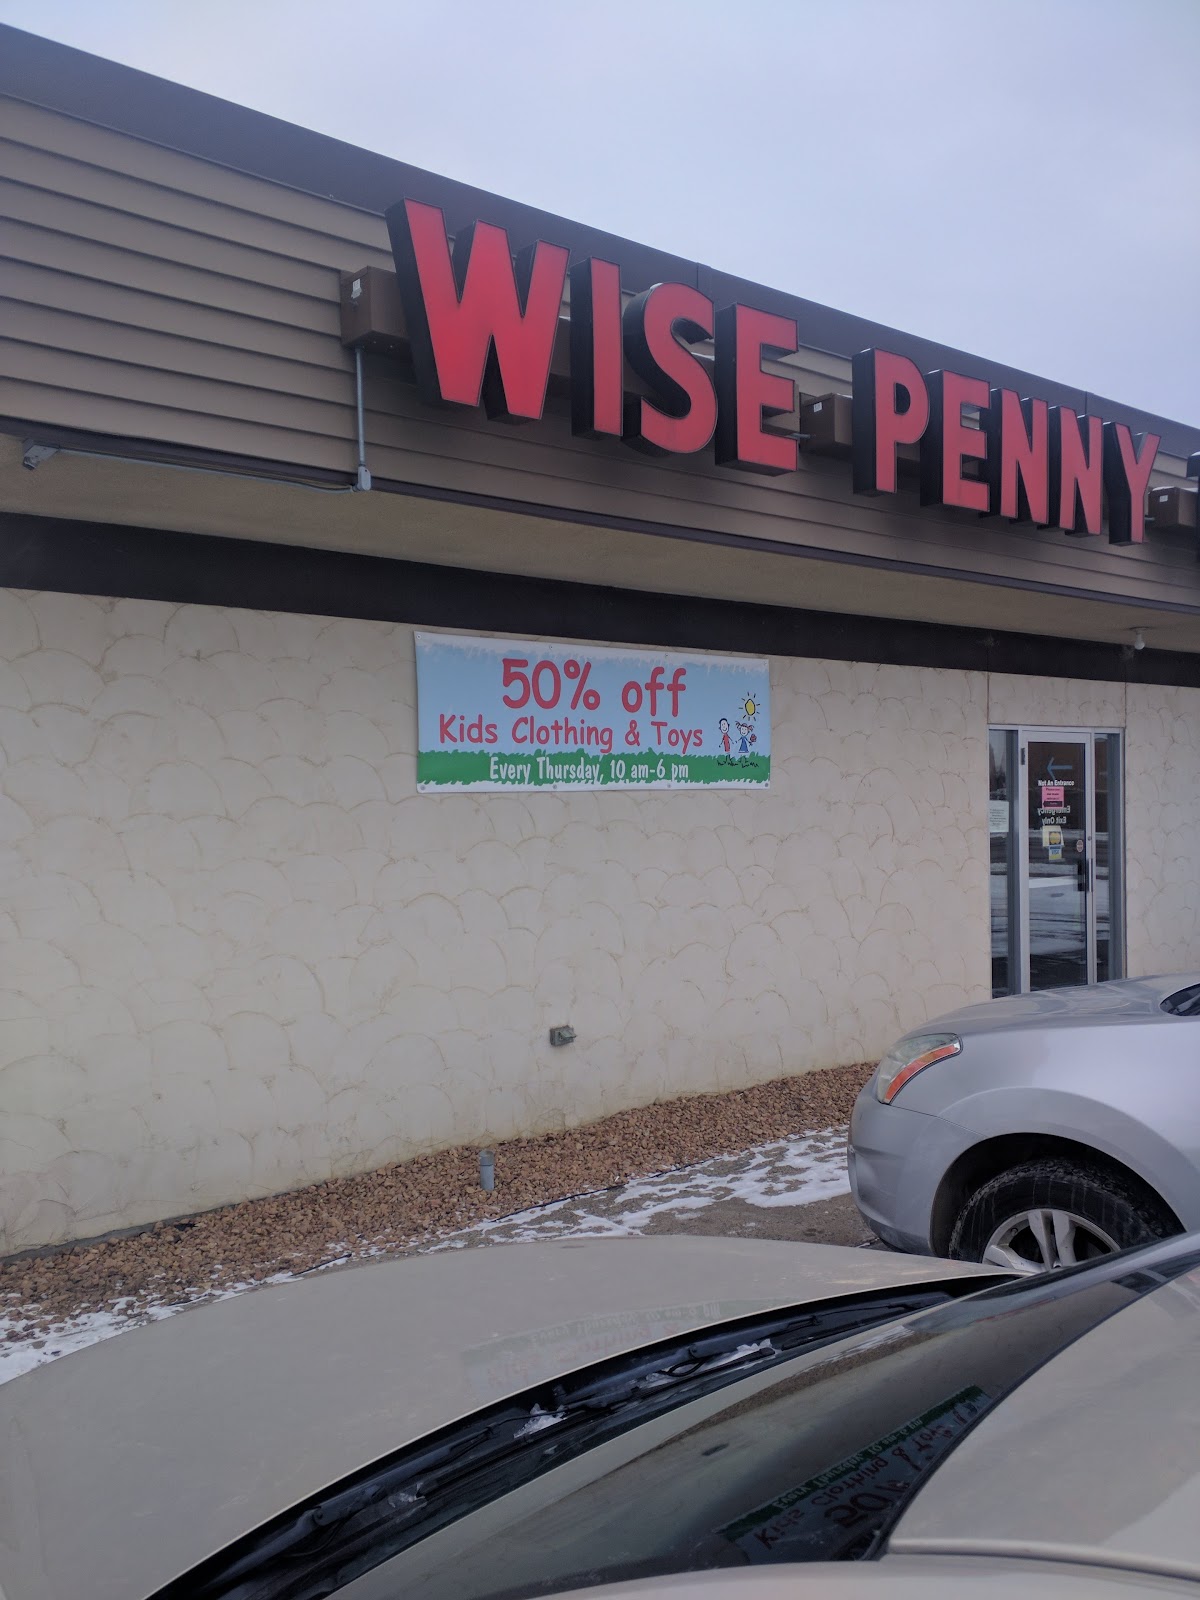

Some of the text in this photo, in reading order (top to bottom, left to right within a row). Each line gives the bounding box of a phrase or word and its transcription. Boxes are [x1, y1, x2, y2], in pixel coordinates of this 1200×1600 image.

[400, 197, 1161, 544] WISE PENNY
[501, 657, 687, 718] 50% off
[439, 713, 703, 755] Kids Clothing & Toys
[489, 756, 531, 784] Every
[536, 756, 603, 785] Thursday,
[610, 759, 626, 779] 10
[671, 763, 689, 782] pm
